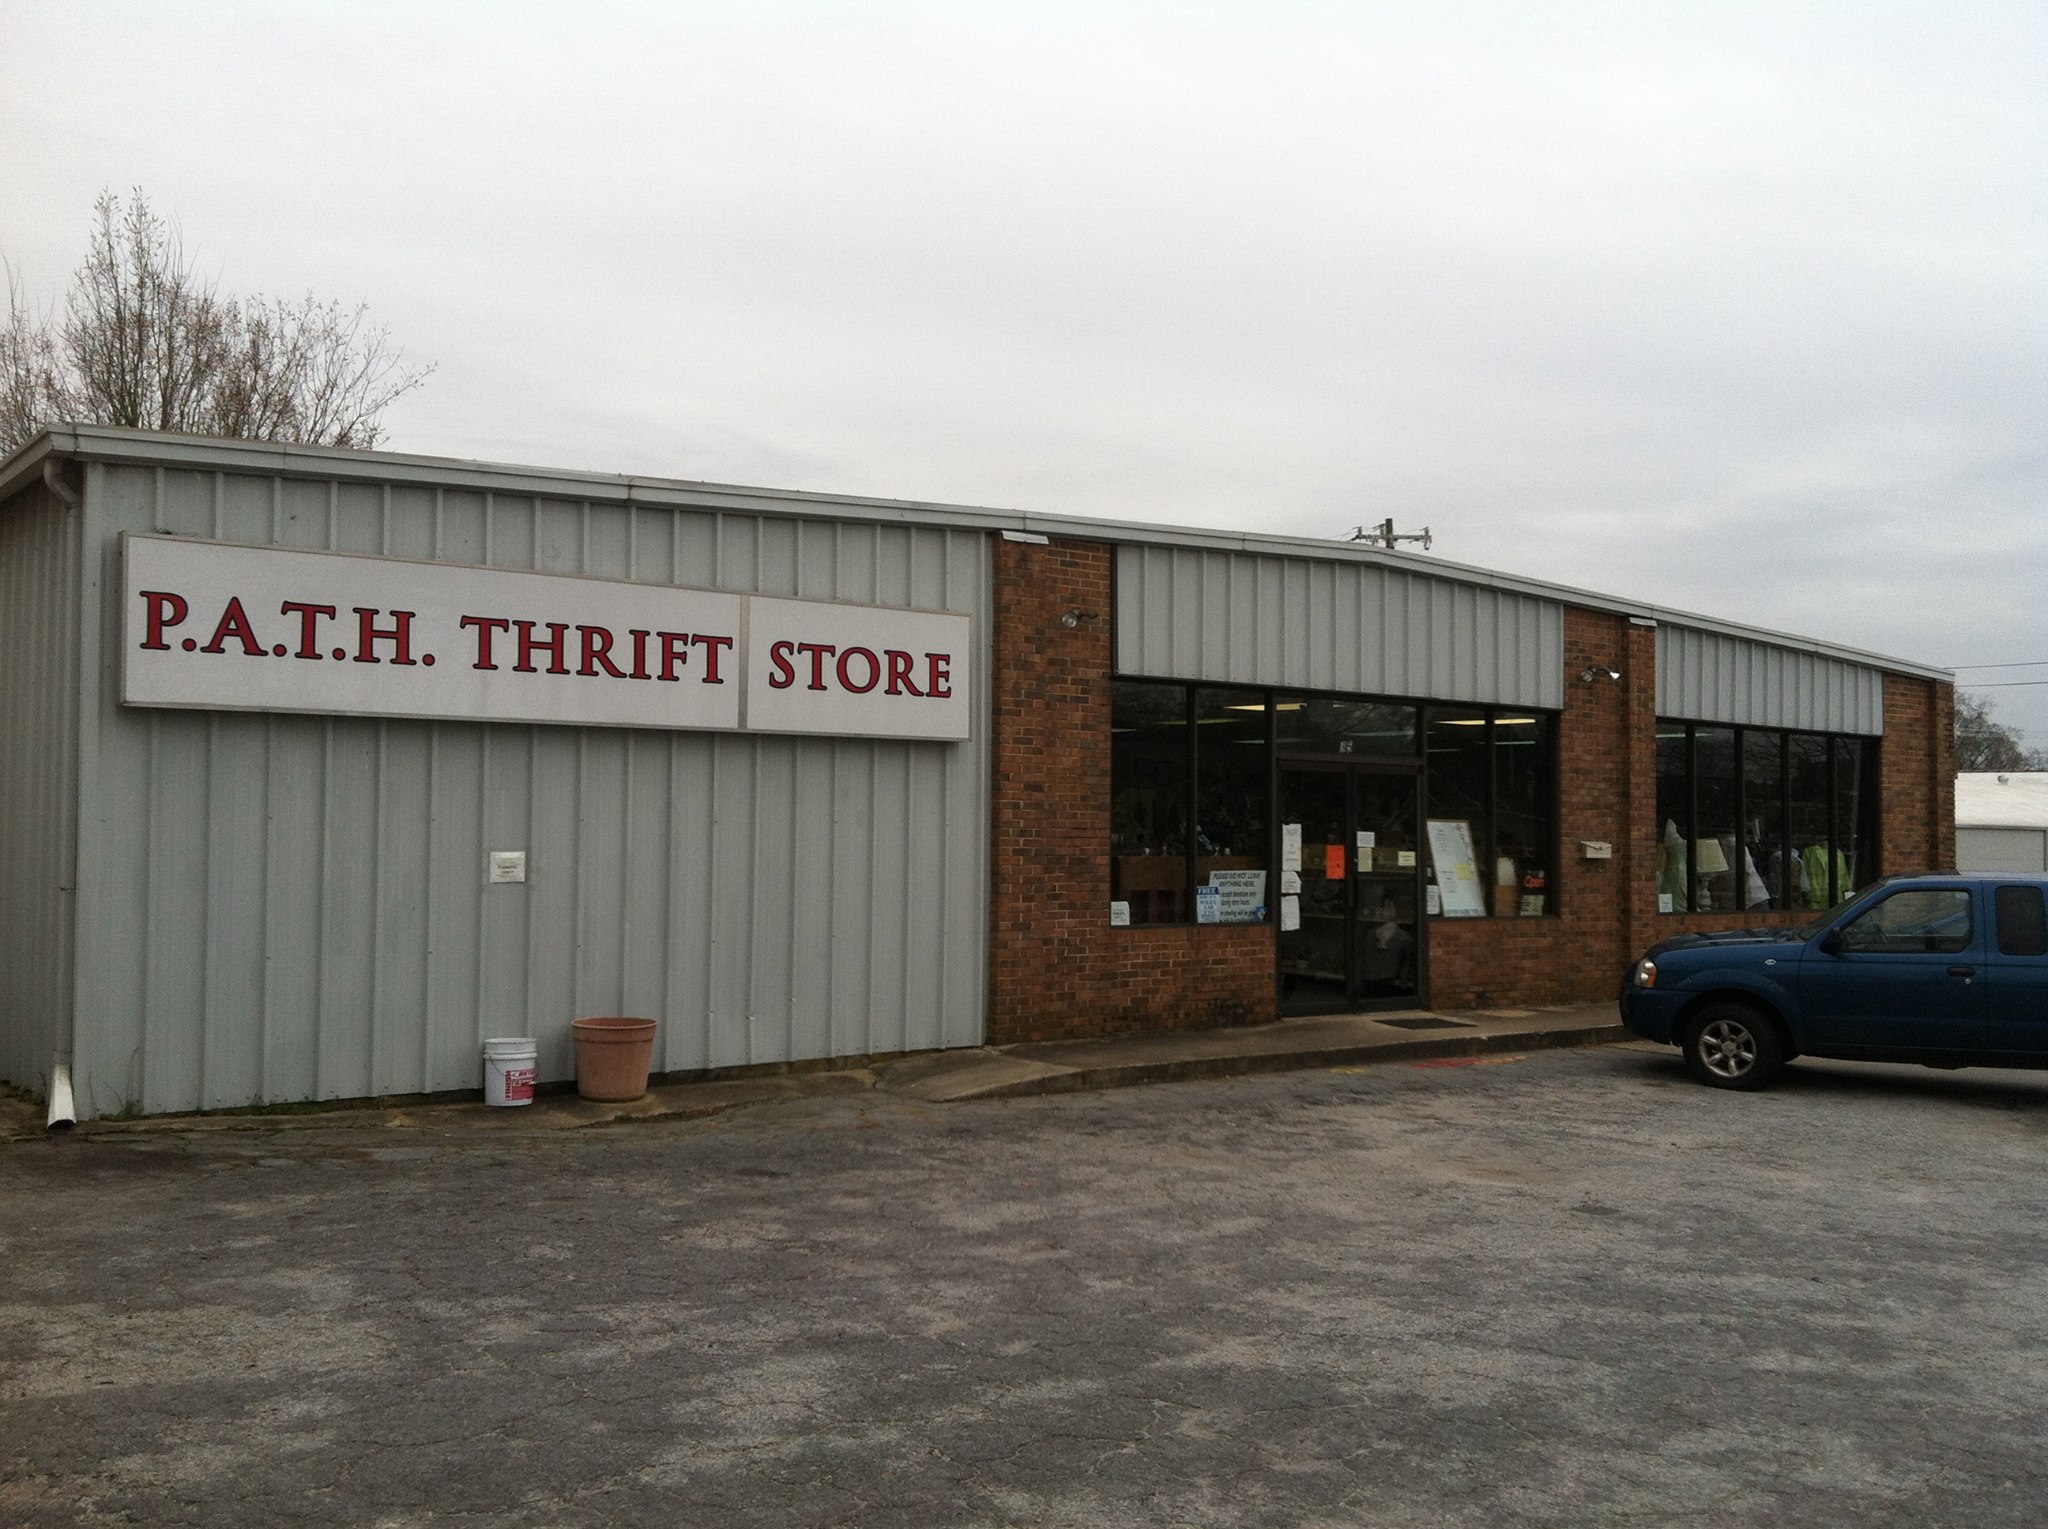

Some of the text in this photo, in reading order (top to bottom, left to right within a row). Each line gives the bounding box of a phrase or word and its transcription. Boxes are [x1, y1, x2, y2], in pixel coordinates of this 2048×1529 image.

[139, 590, 952, 699] P.A.T.H. THRIFT STORE
